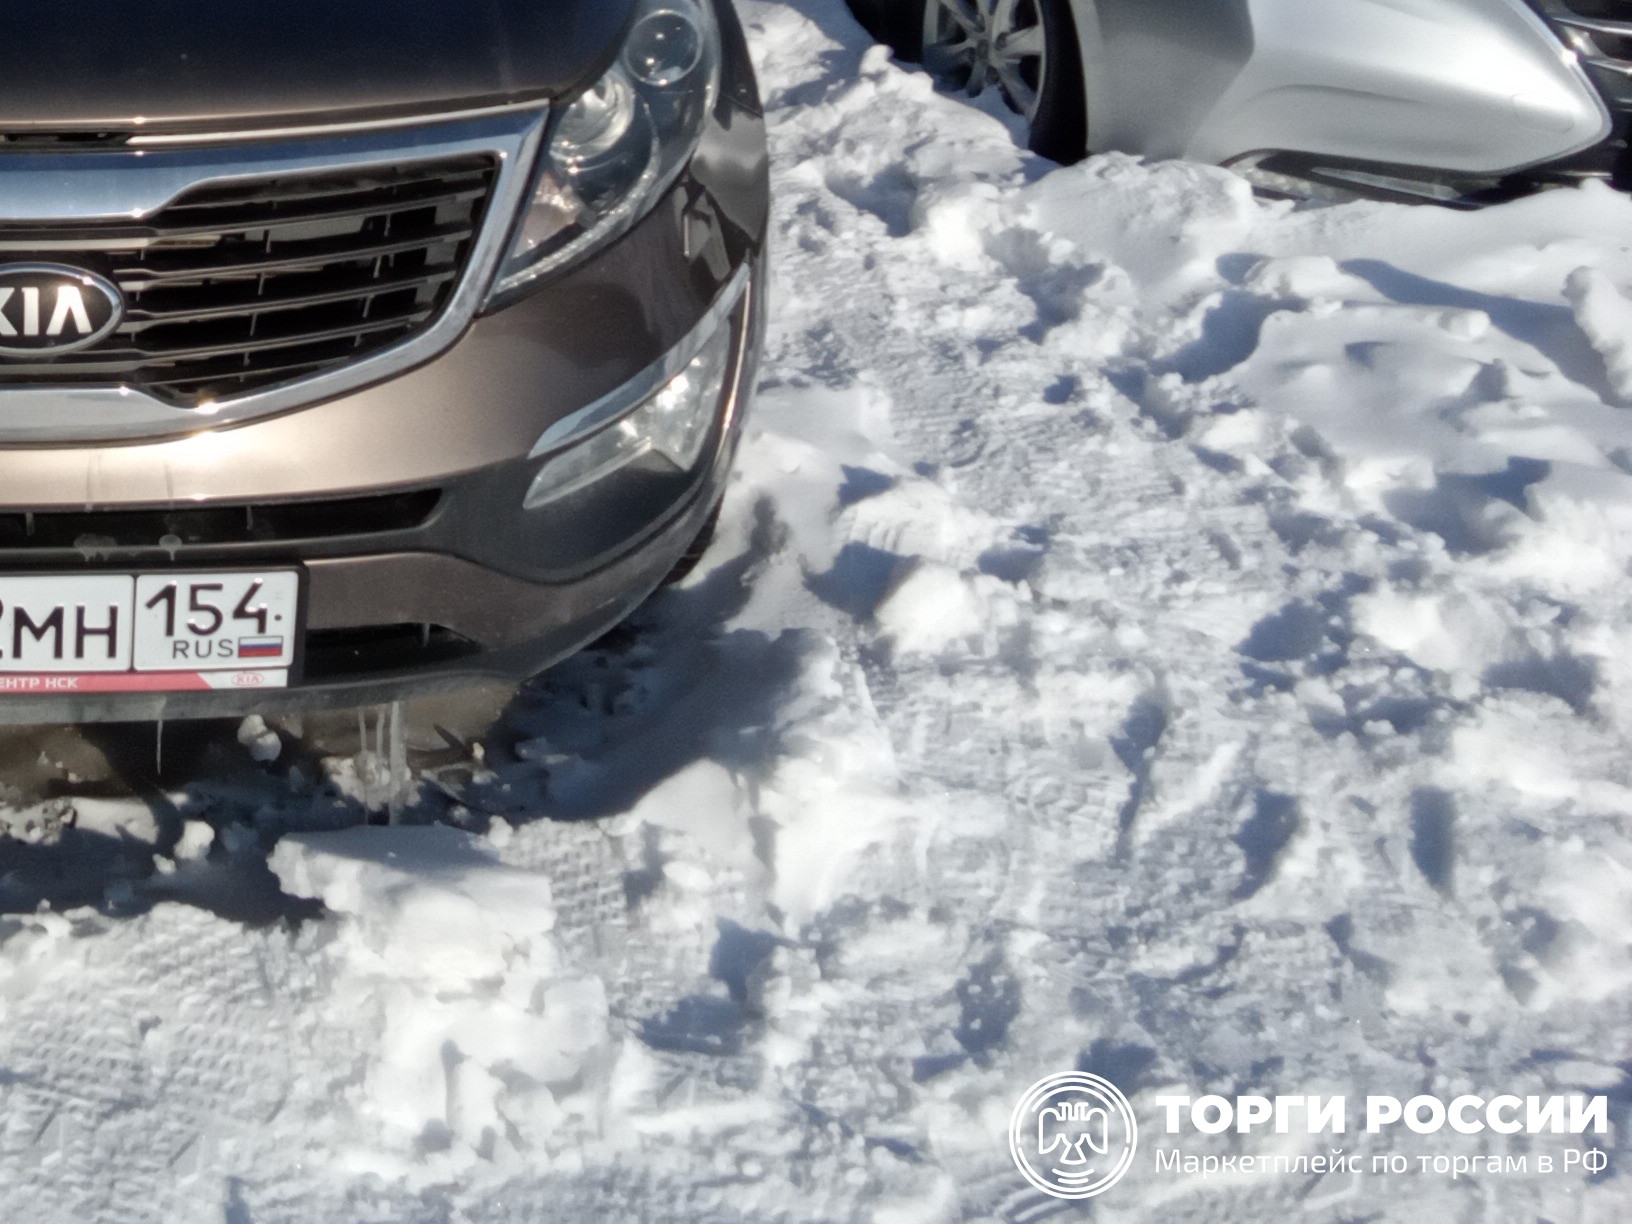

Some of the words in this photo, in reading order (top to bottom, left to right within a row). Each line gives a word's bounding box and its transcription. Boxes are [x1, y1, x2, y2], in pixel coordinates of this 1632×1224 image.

[145, 578, 268, 637] 154
[172, 639, 234, 659] RUS
[45, 676, 79, 689] НСК
[234, 674, 261, 686] KIA
